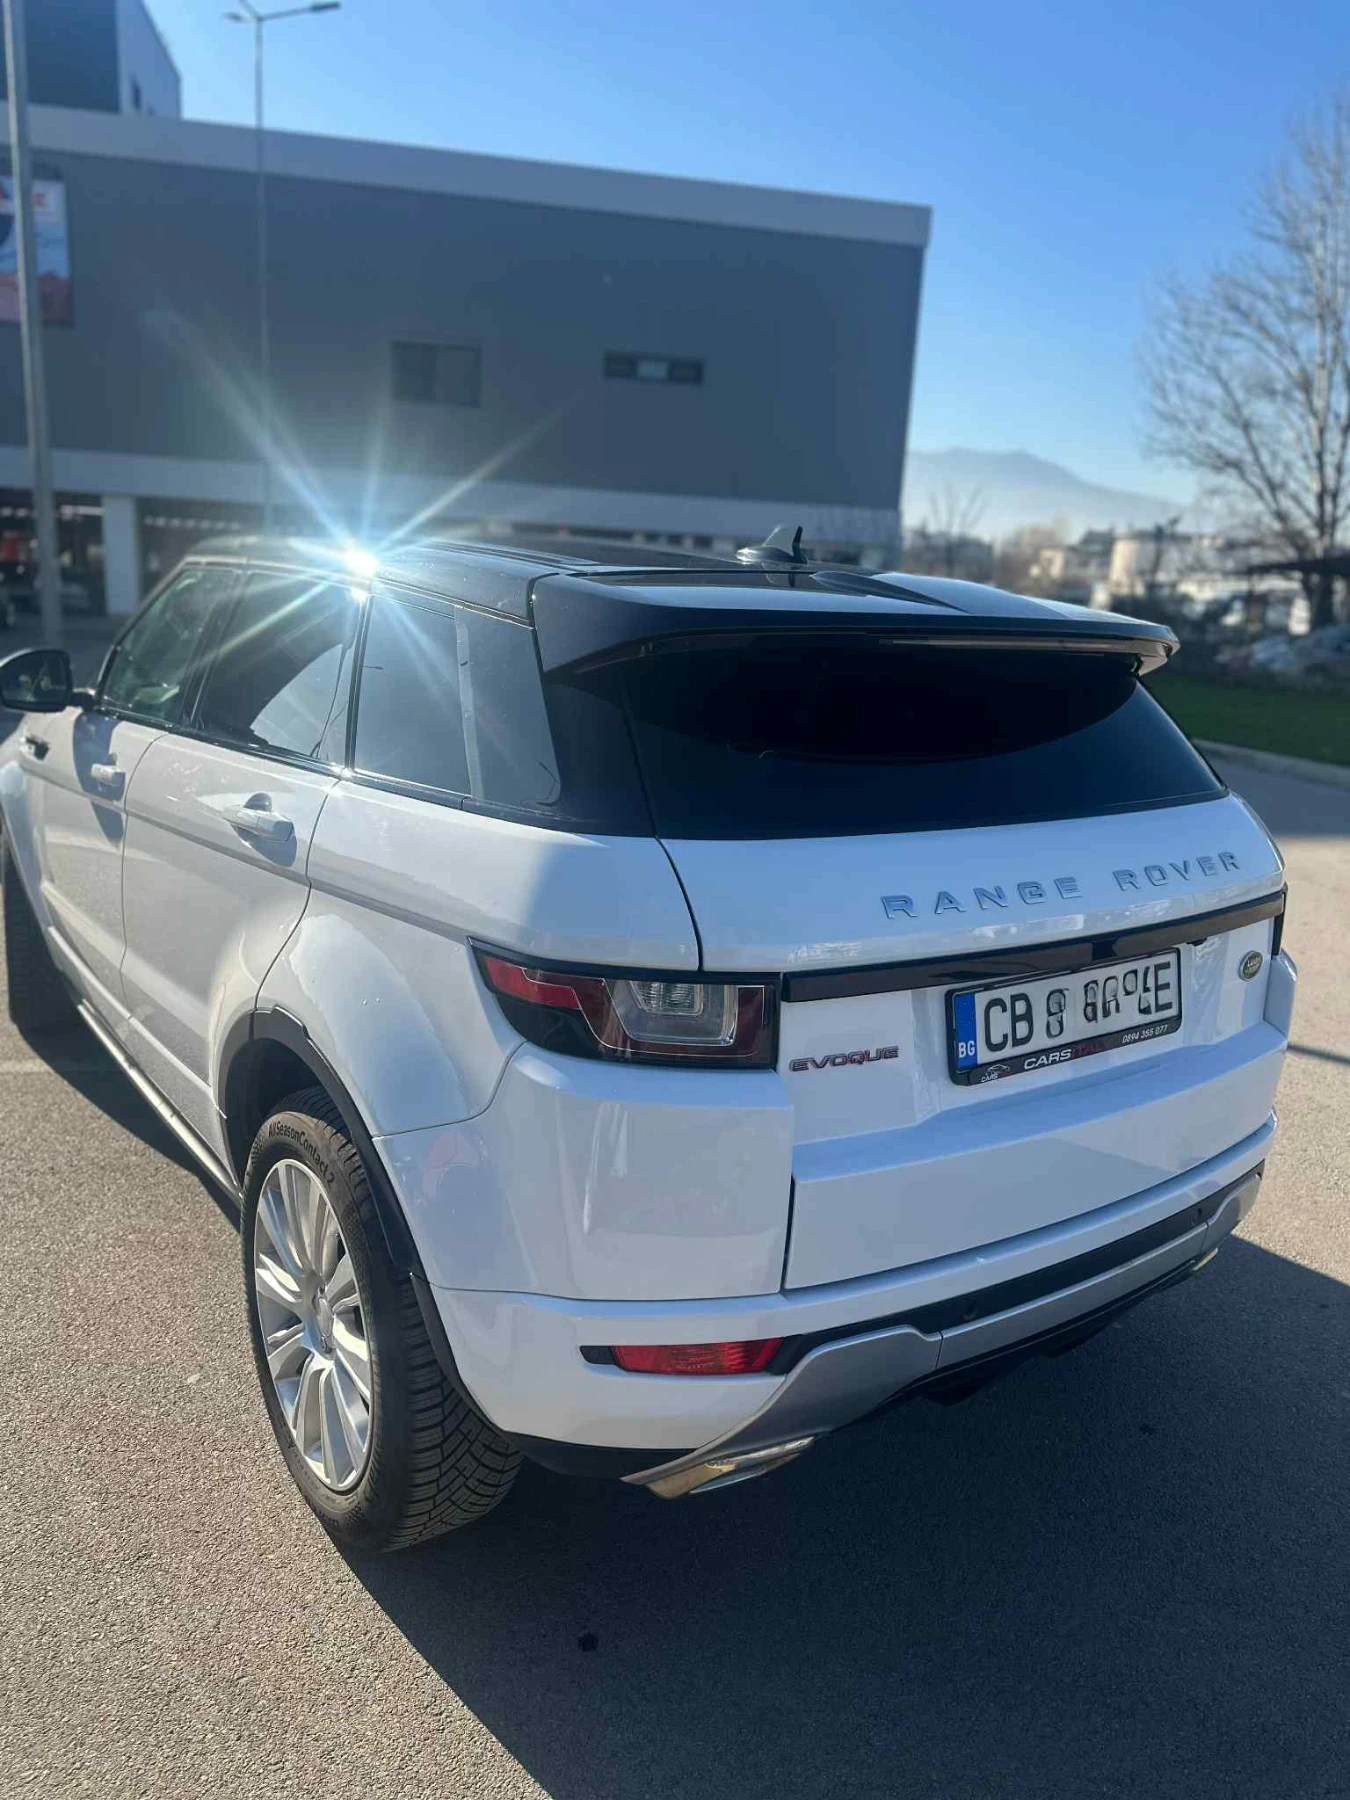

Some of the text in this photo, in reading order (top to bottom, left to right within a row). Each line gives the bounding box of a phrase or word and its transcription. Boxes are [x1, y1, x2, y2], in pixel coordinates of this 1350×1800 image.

[880, 851, 1241, 919] RANGE ROVER
[789, 1045, 899, 1072] EVOQUE
[958, 1040, 976, 1059] BG
[1024, 1049, 1072, 1070] CARS
